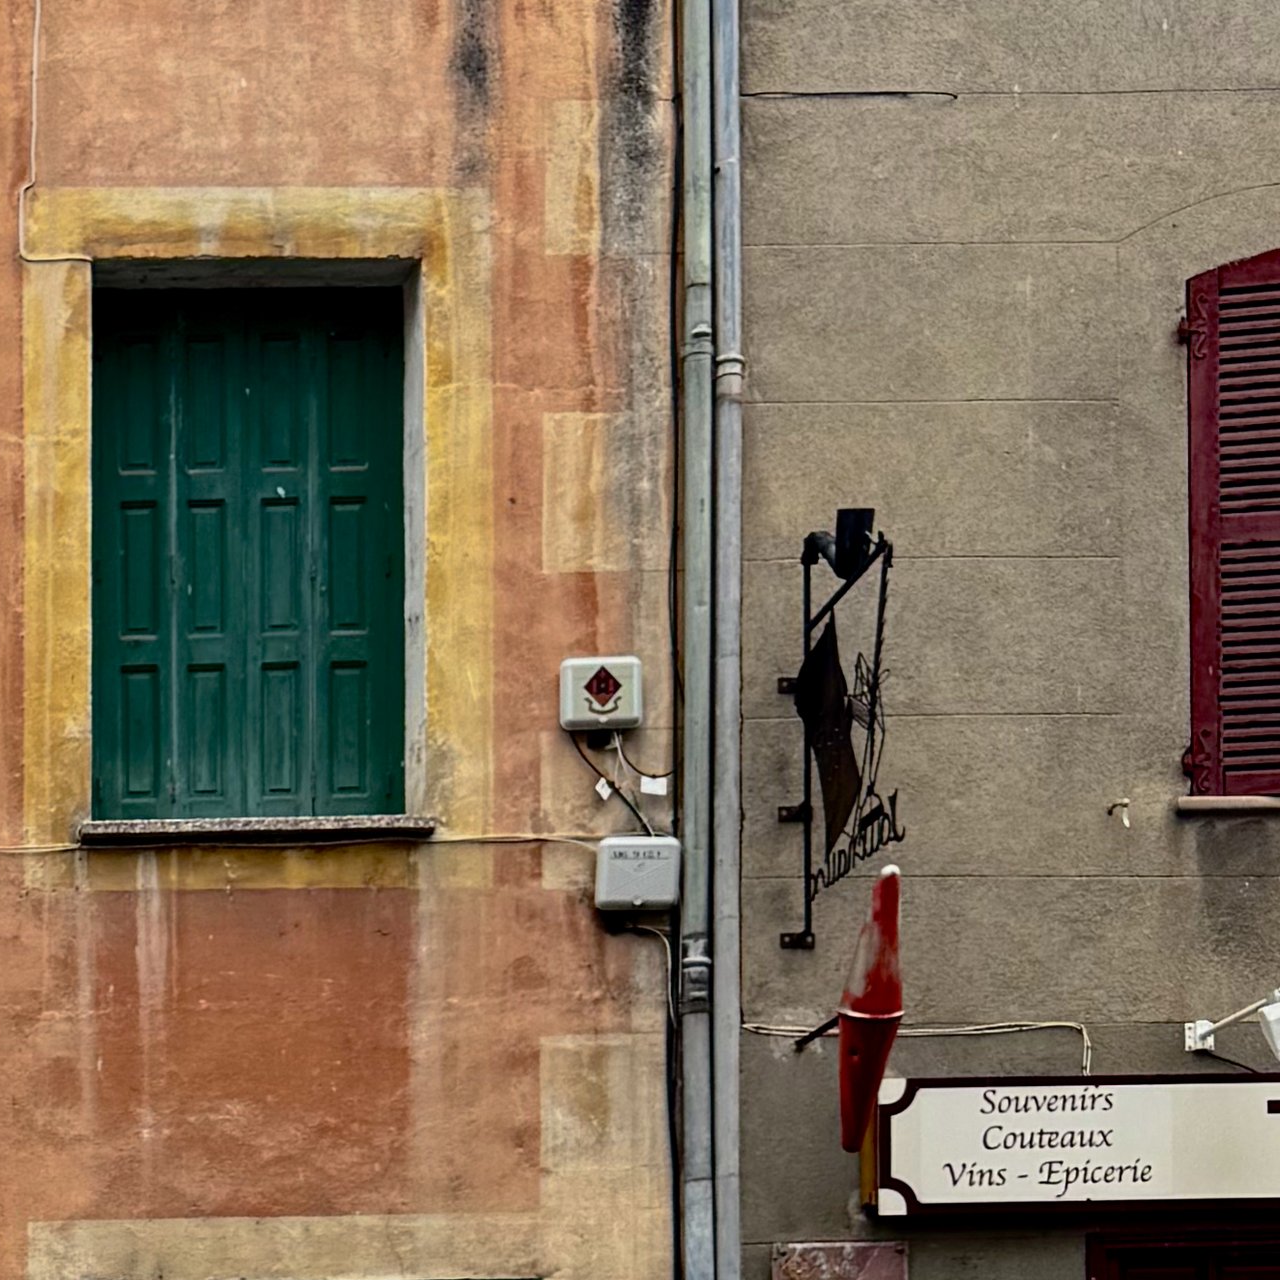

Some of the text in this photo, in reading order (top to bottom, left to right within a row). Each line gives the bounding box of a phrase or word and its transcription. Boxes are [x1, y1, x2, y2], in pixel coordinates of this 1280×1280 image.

[980, 1087, 1113, 1115] Souvenirs
[983, 1126, 1113, 1150] Couteaux
[943, 1162, 1007, 1187] Vins
[1038, 1158, 1153, 1198] Epicerie
